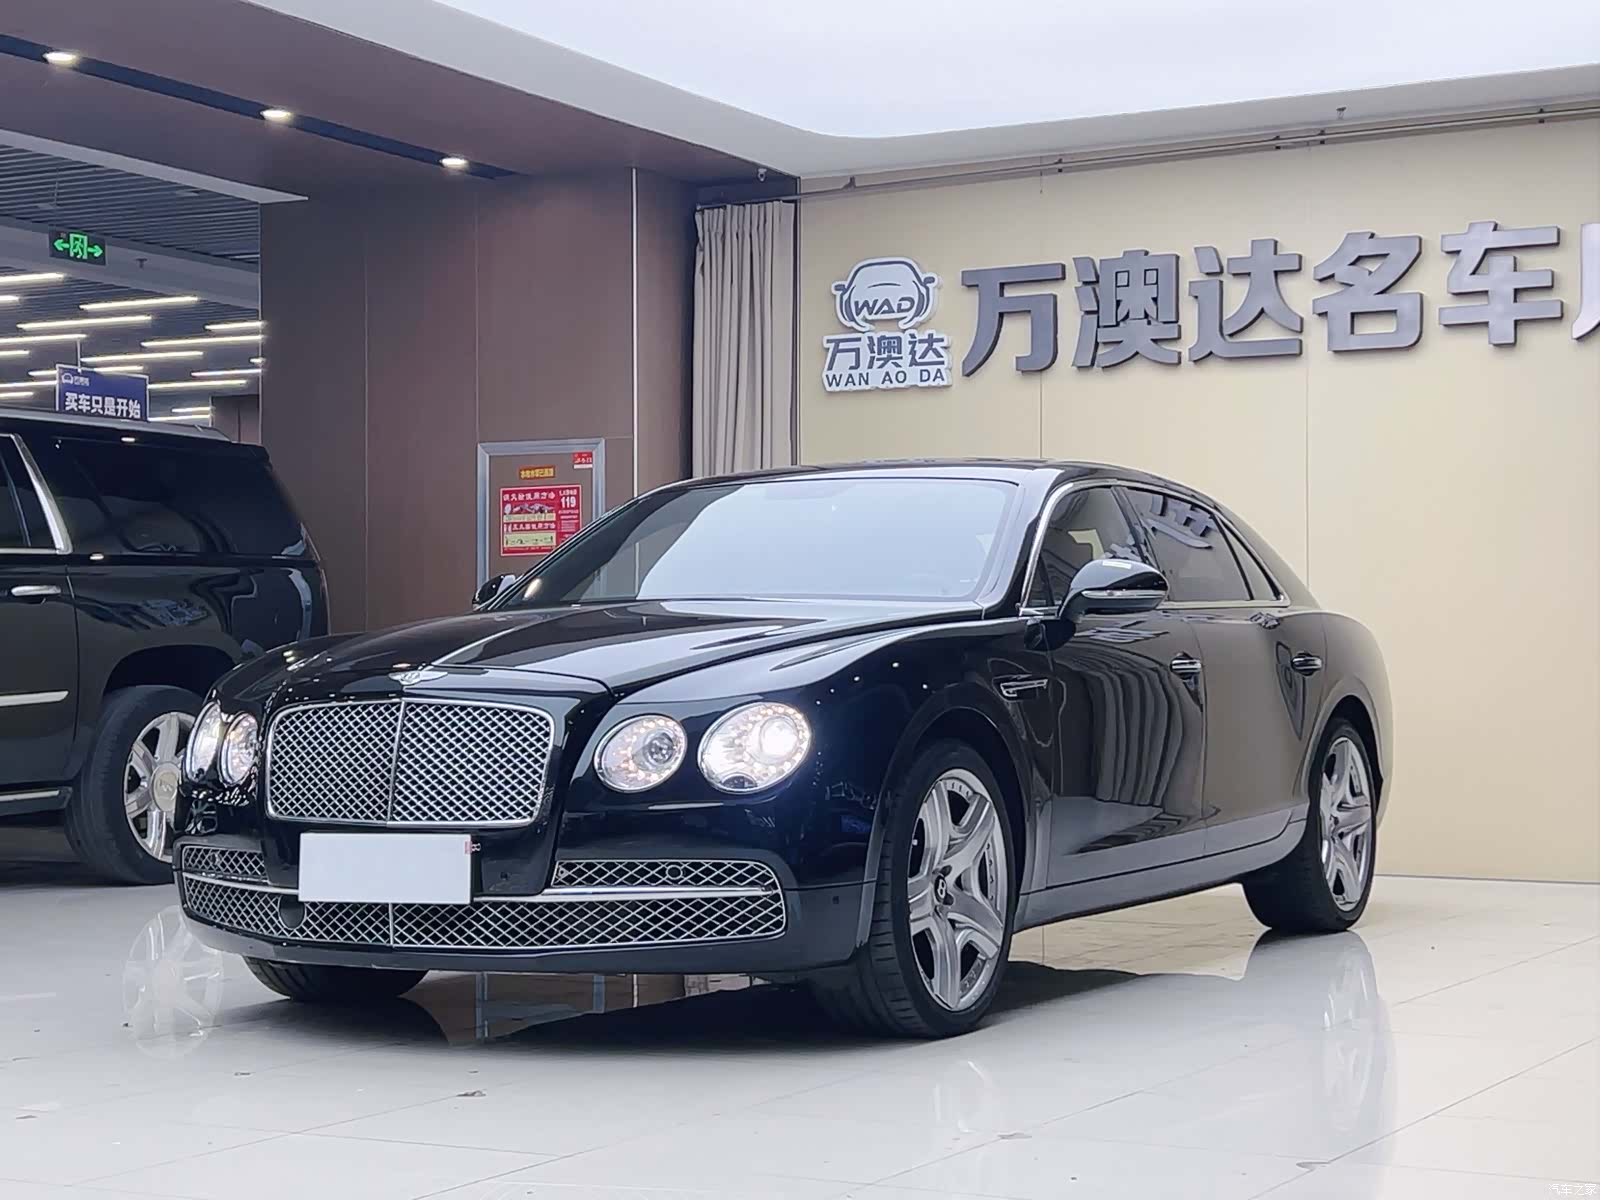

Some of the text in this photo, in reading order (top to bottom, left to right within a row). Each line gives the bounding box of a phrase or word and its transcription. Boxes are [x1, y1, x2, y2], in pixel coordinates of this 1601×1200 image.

[854, 296, 916, 317] WAD
[961, 221, 1600, 377] 万澳达名车
[826, 333, 945, 371] 万澳达
[825, 368, 946, 388] WAN AO DA
[64, 391, 141, 419] 买车只是开始
[560, 496, 577, 509] 119
